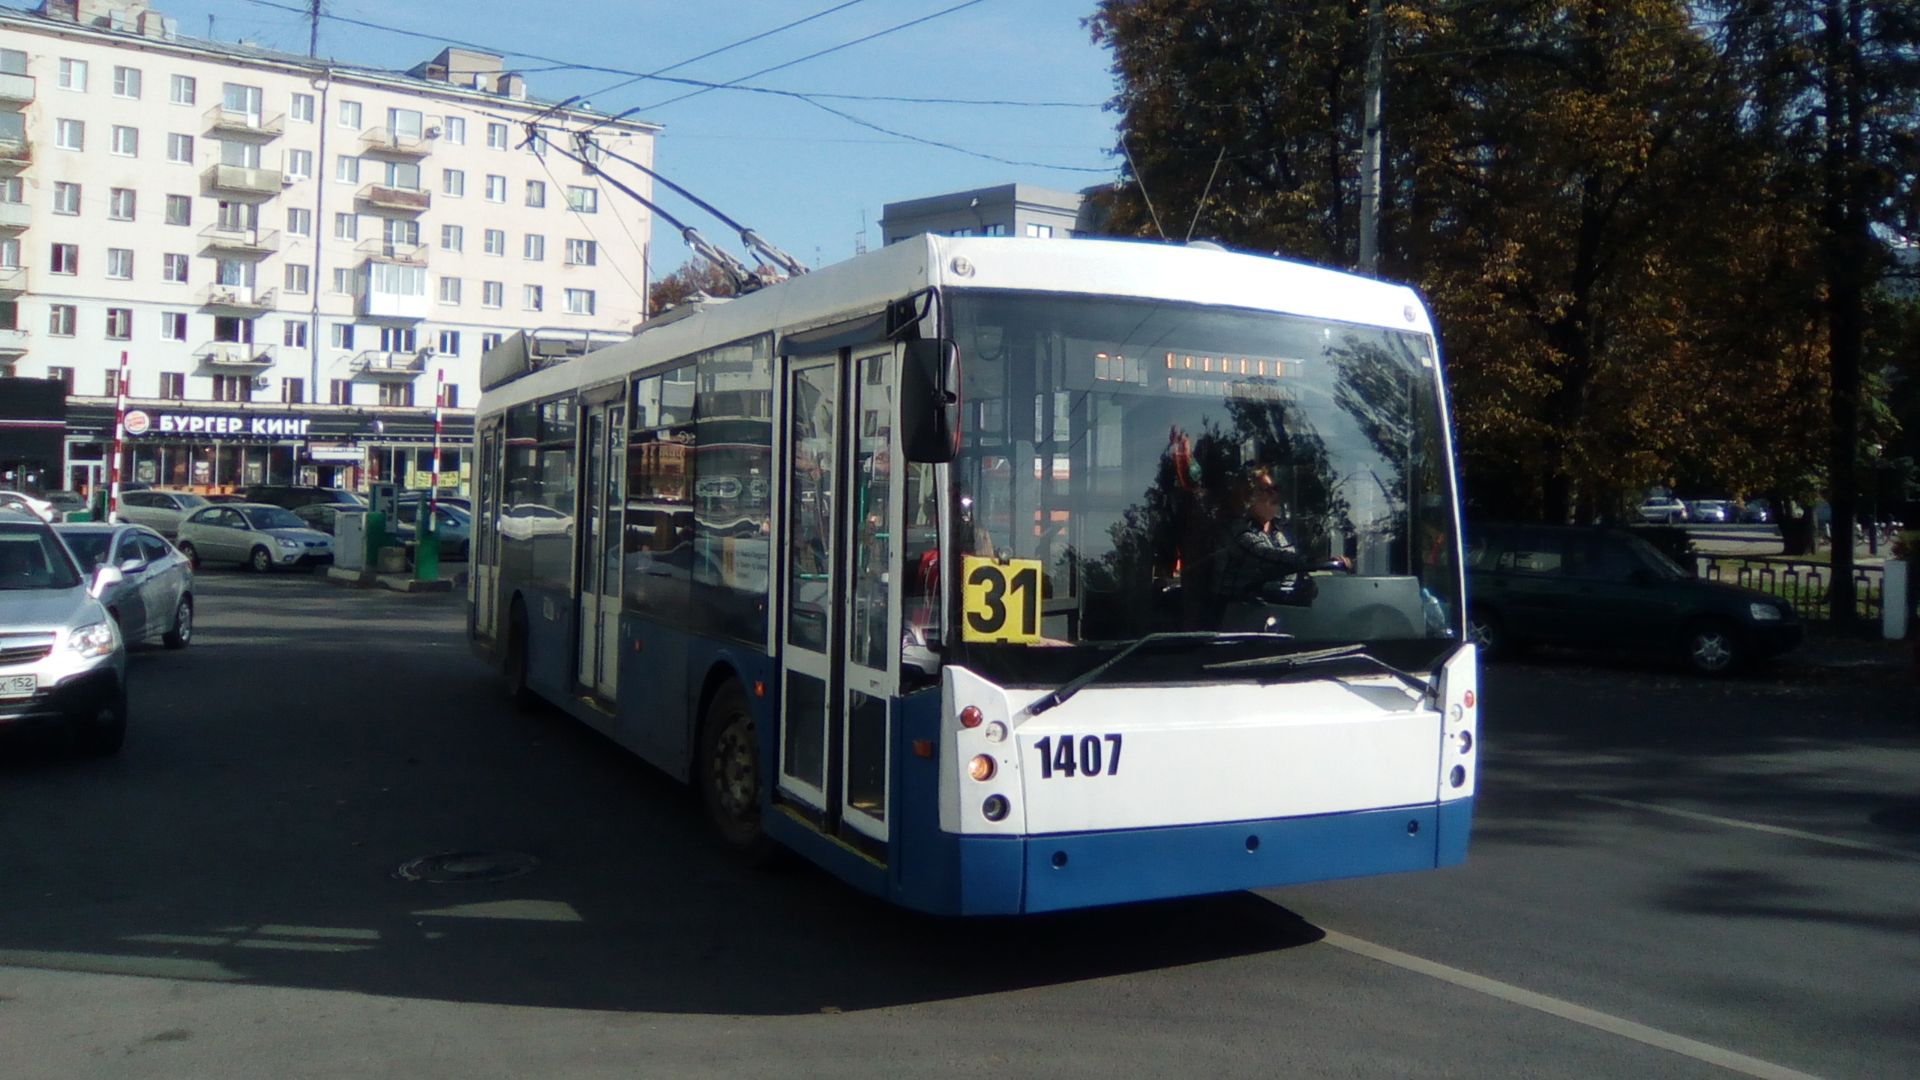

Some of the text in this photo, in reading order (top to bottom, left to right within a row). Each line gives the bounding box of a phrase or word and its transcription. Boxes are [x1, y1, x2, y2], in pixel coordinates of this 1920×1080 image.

[159, 415, 243, 433] БУРГЕР
[251, 418, 311, 435] КИНГ
[967, 566, 1037, 635] 31
[11, 677, 33, 688] 152
[1034, 733, 1122, 779] 1407
